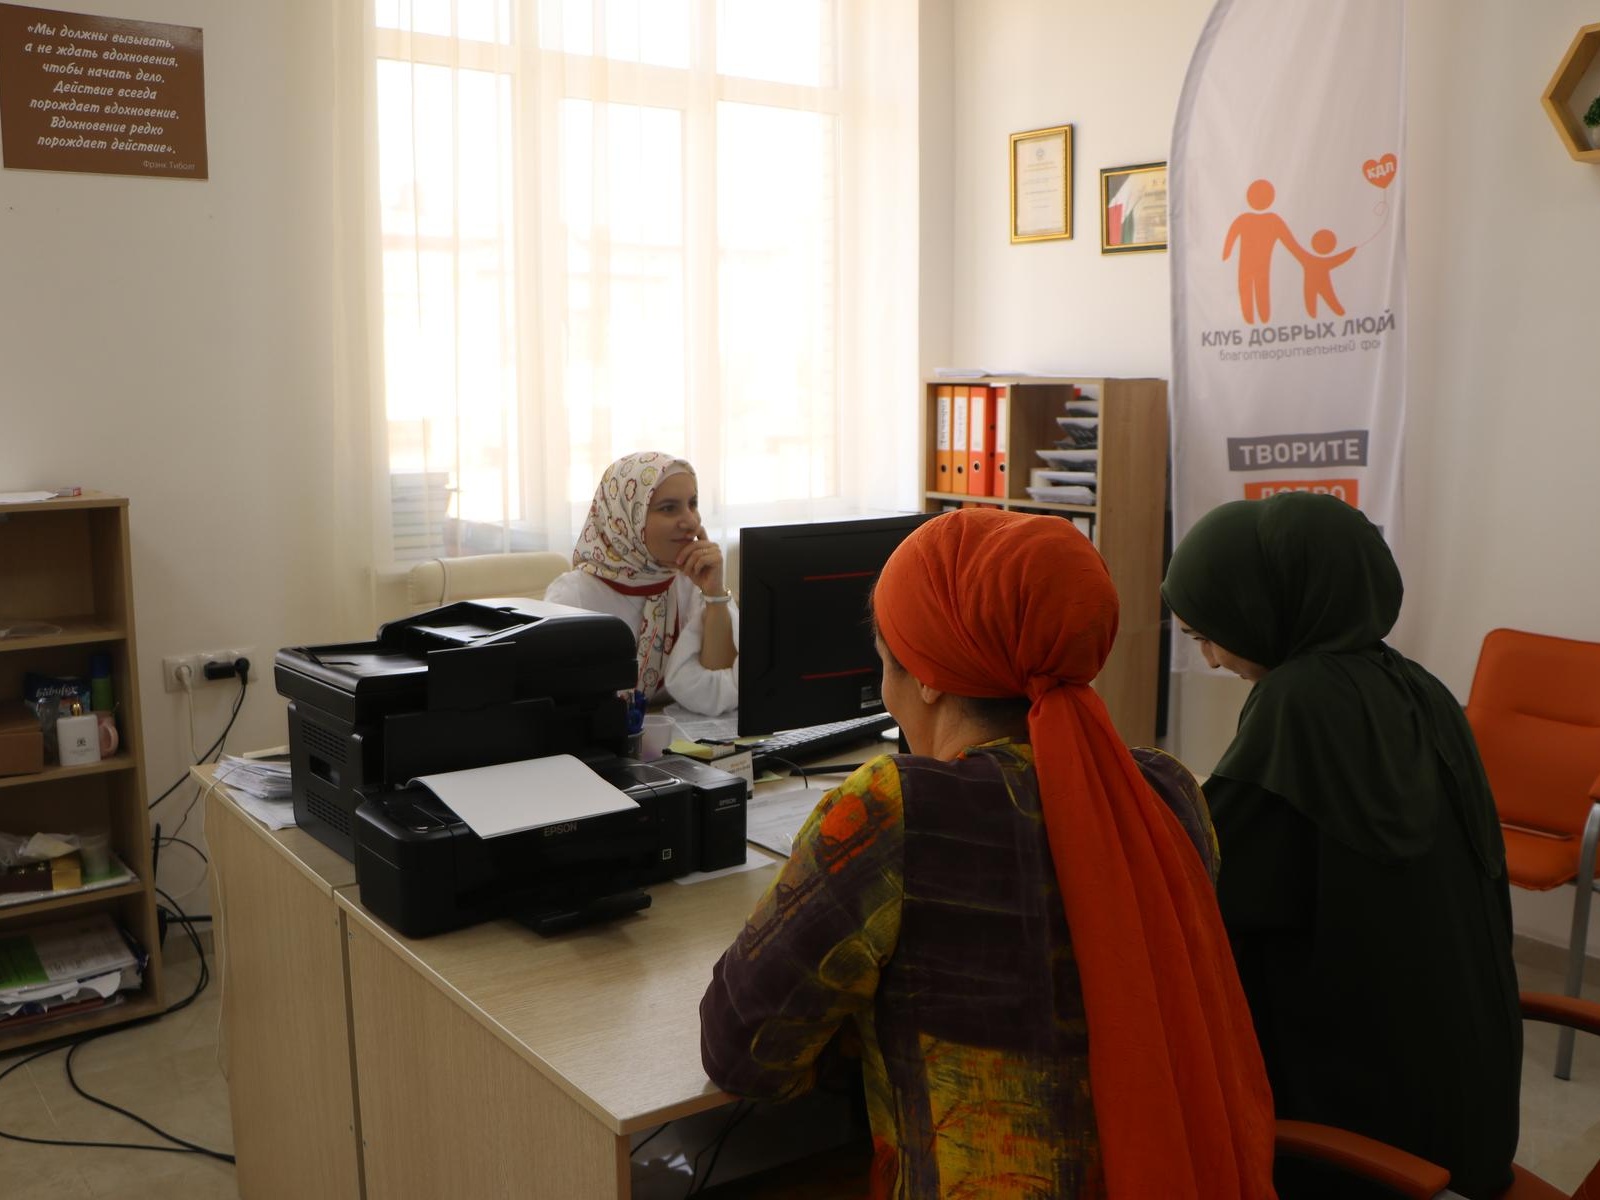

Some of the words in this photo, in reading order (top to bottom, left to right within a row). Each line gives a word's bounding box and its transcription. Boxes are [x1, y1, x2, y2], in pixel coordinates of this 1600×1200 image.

[60, 24, 108, 42] должны
[25, 43, 32, 52] а
[37, 44, 52, 54] не
[56, 43, 98, 58] ждать
[42, 62, 83, 75] чтобы
[87, 67, 132, 80] начать
[136, 69, 165, 83] дело.
[53, 80, 113, 96] Действие
[118, 85, 157, 100] всегда
[29, 98, 100, 114] порождает
[104, 102, 179, 119] вдохновение.
[50, 116, 126, 133] Вдохновение
[129, 121, 164, 136] редко
[37, 135, 107, 149] порождает
[1201, 330, 1243, 347] КЛУБ
[1248, 322, 1337, 347] ДОБРЫХ
[1219, 339, 1356, 361] благотворительный
[1239, 438, 1360, 465] ТВОРИТЕ
[543, 822, 578, 838] EPSON
